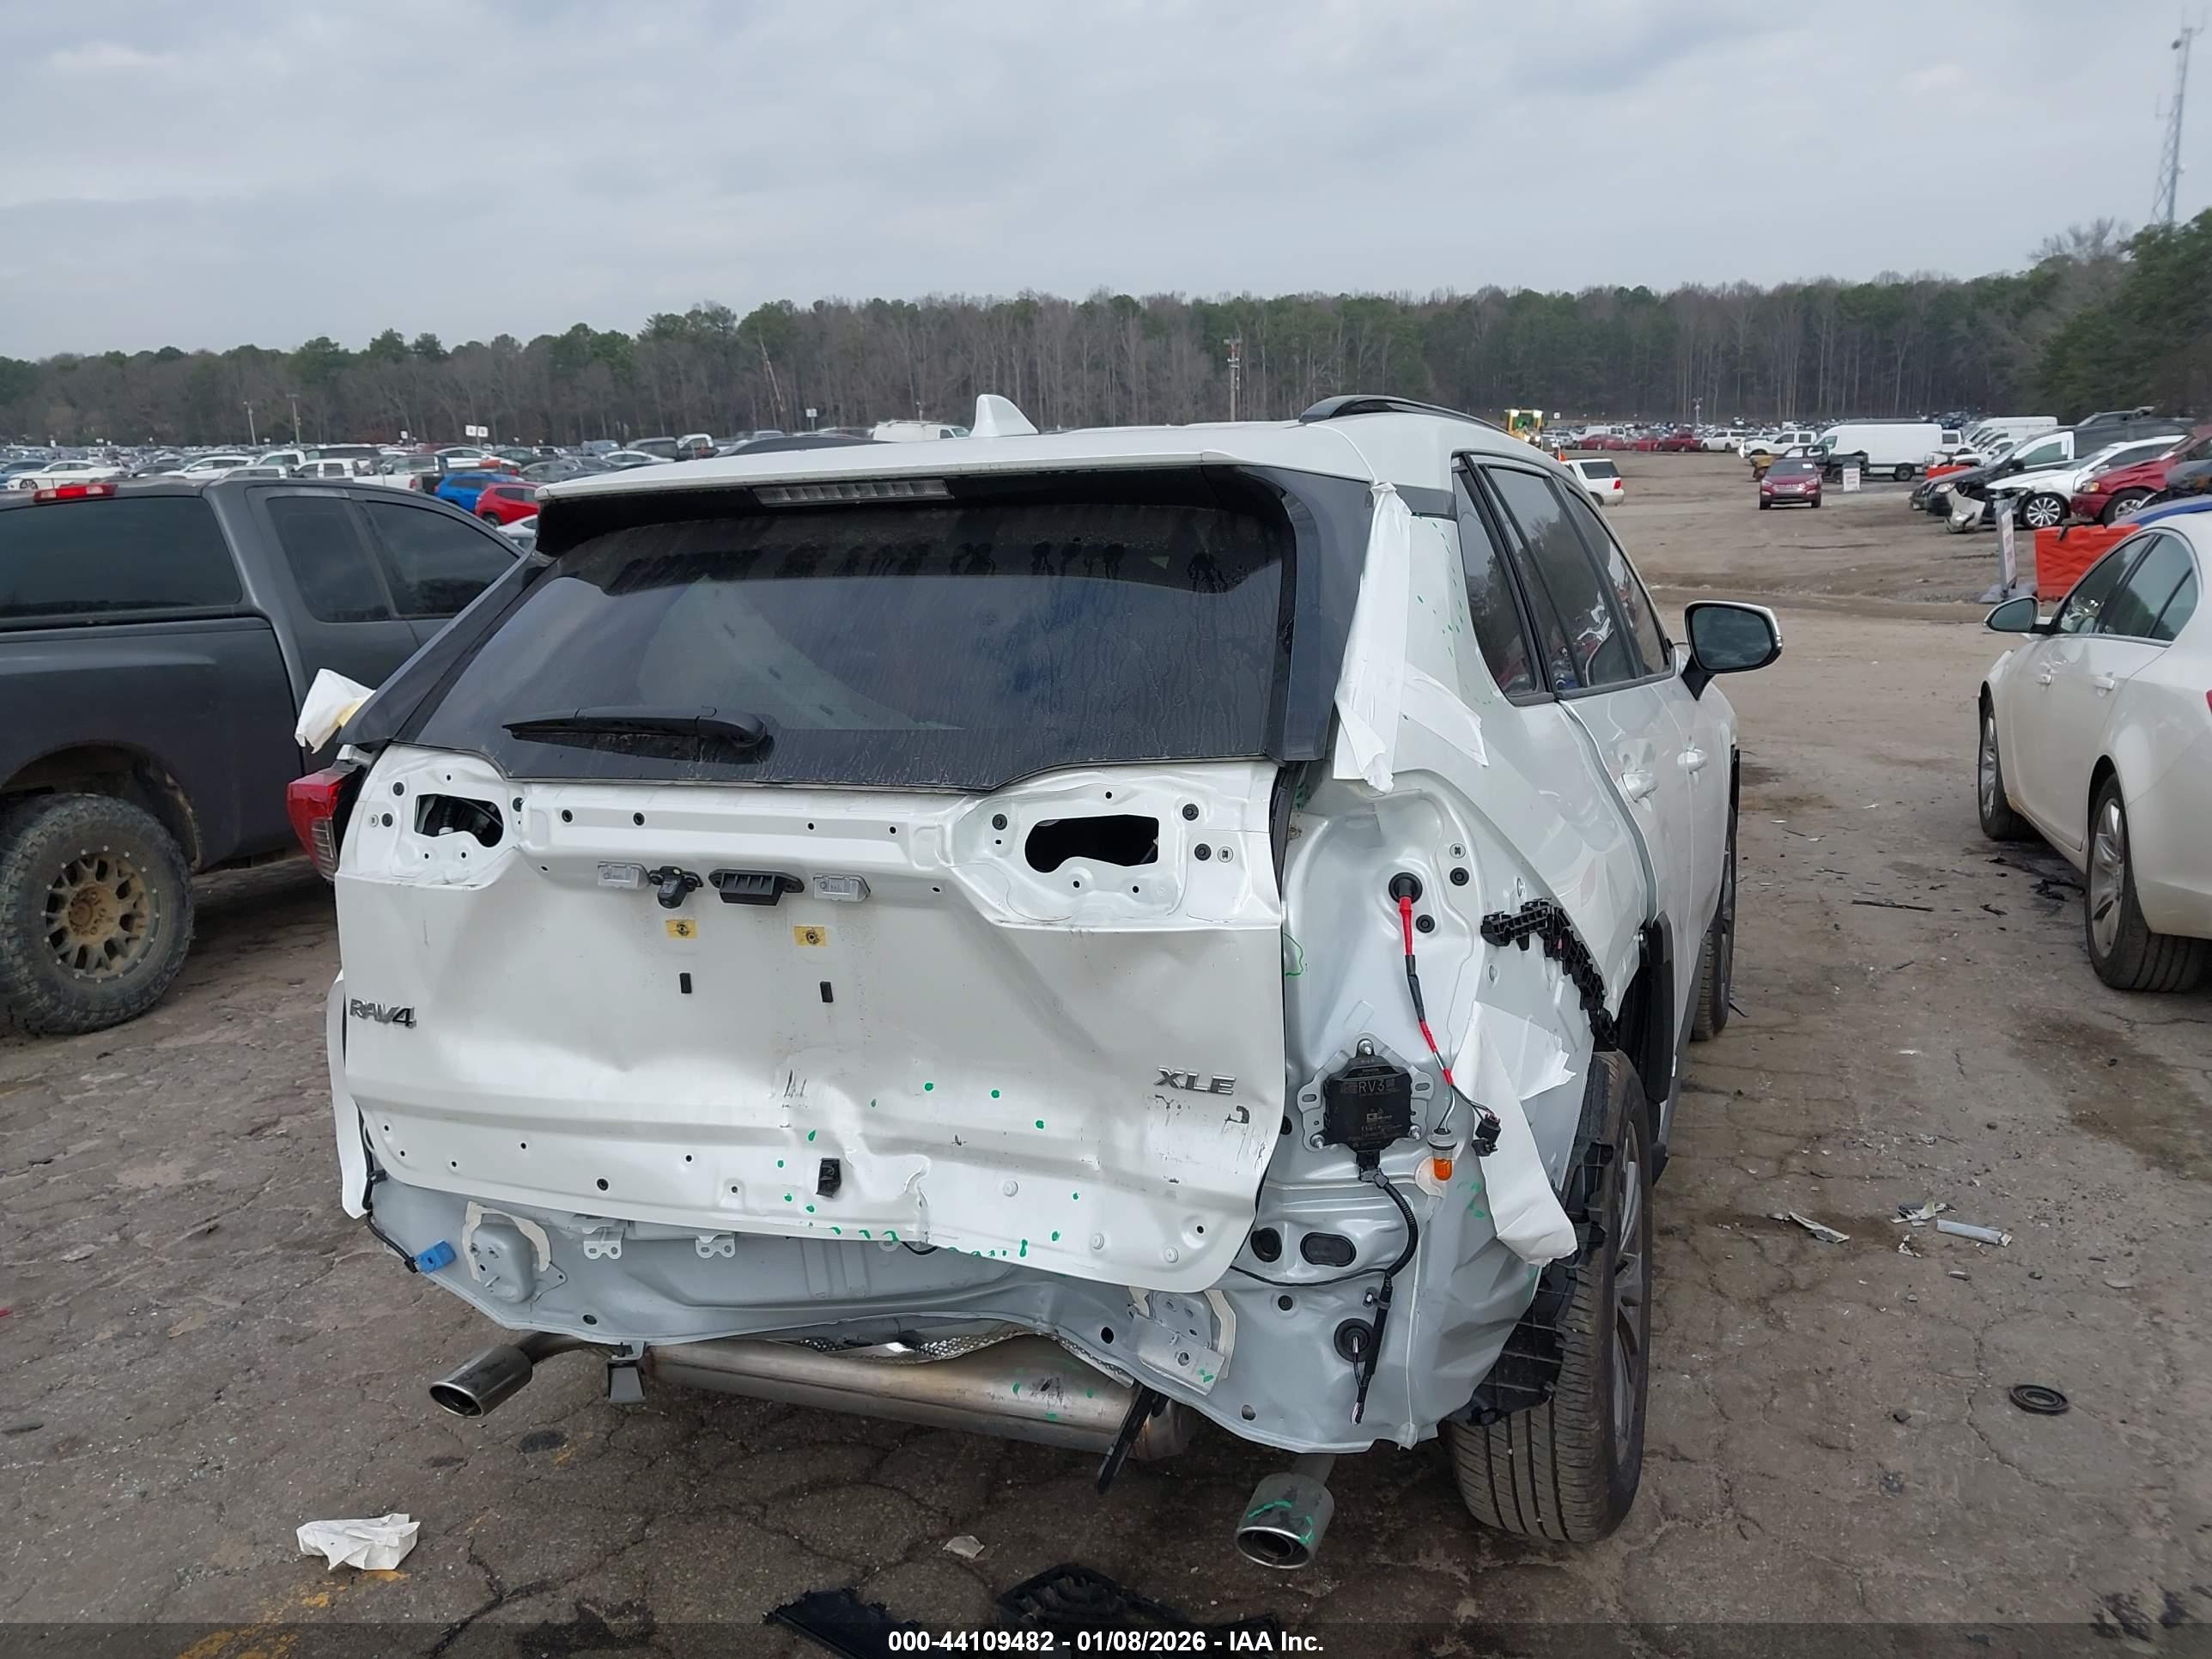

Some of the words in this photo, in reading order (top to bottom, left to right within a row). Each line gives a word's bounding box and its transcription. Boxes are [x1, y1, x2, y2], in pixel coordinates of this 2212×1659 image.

[350, 998, 416, 1029] RAV4
[1154, 1067, 1236, 1095] XLE
[1358, 1079, 1386, 1093] RV3
